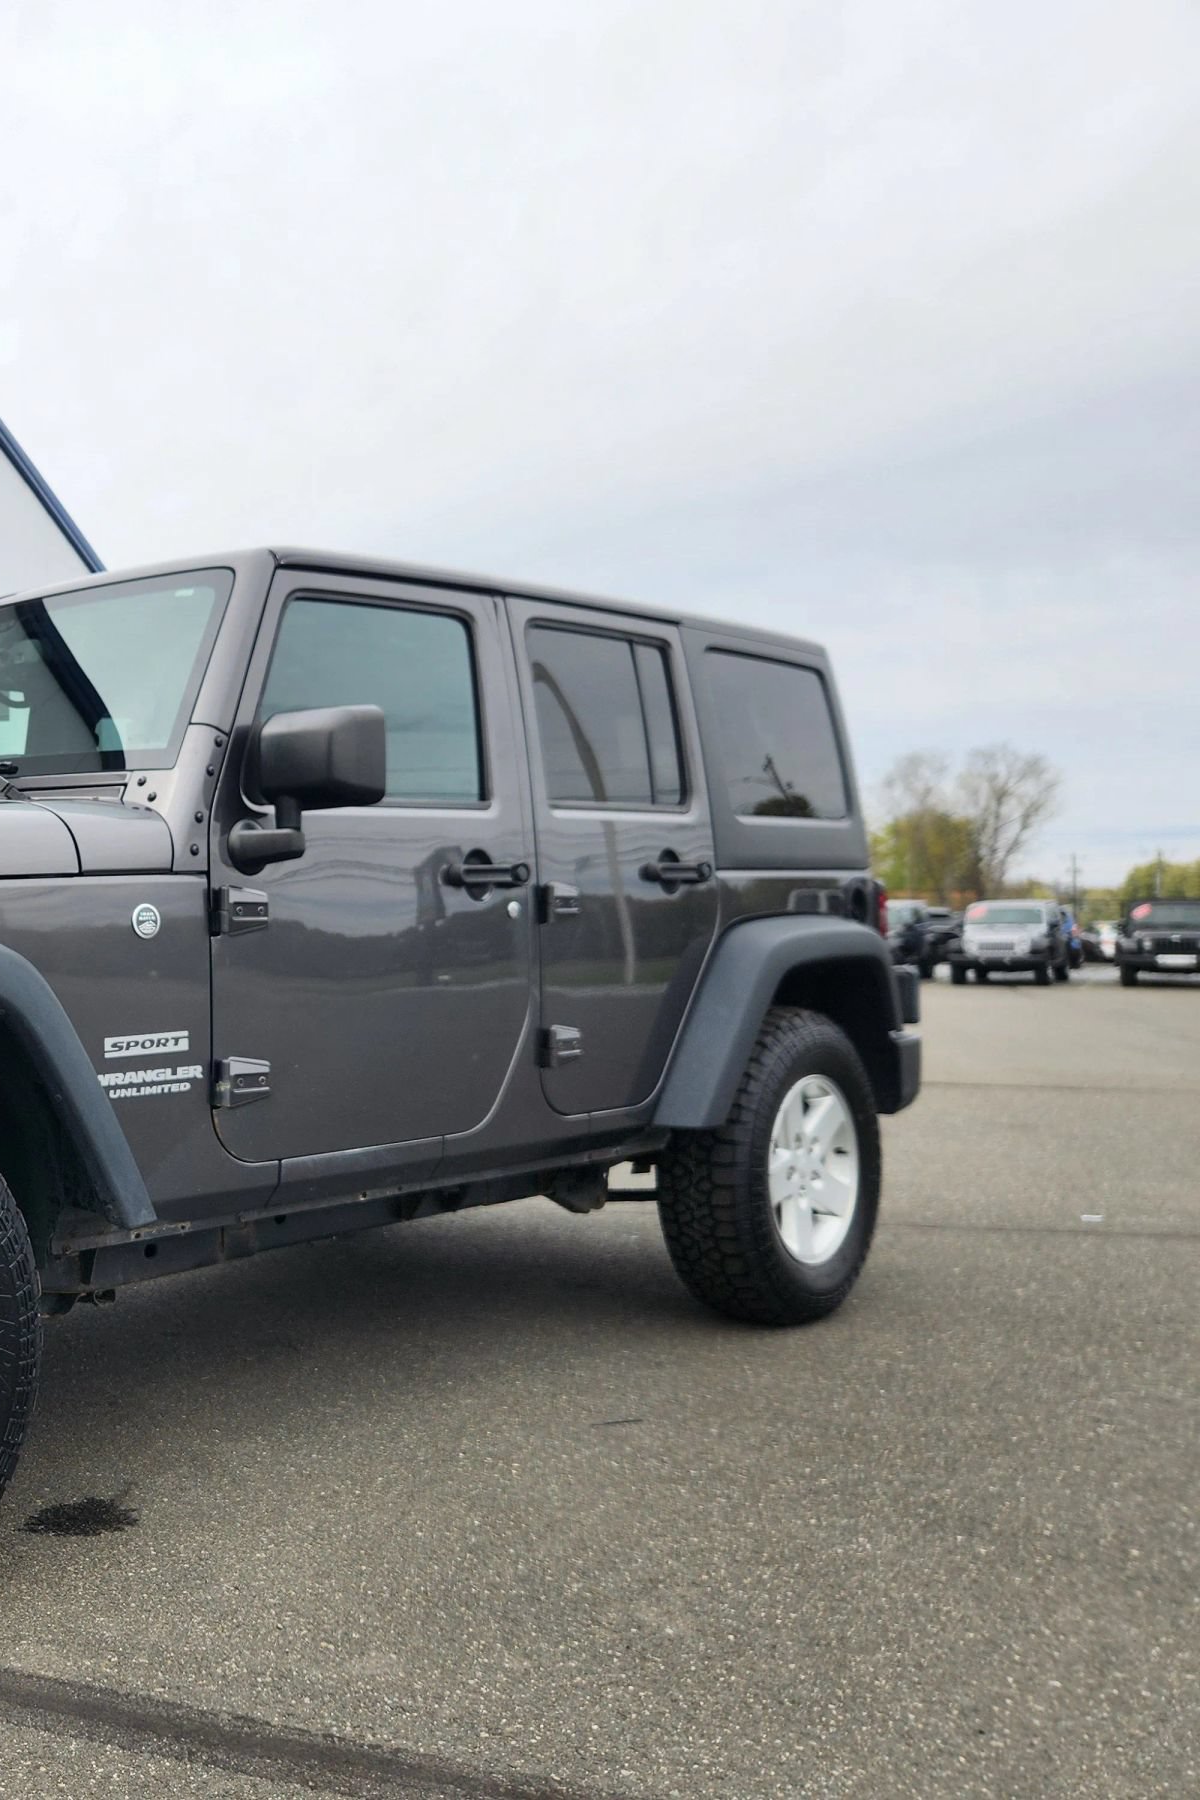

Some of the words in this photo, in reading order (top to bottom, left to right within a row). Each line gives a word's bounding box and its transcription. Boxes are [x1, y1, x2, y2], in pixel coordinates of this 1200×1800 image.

[108, 1034, 186, 1054] SPORT
[97, 1065, 203, 1087] WRANGLER
[109, 1082, 192, 1099] UNLIMITED
